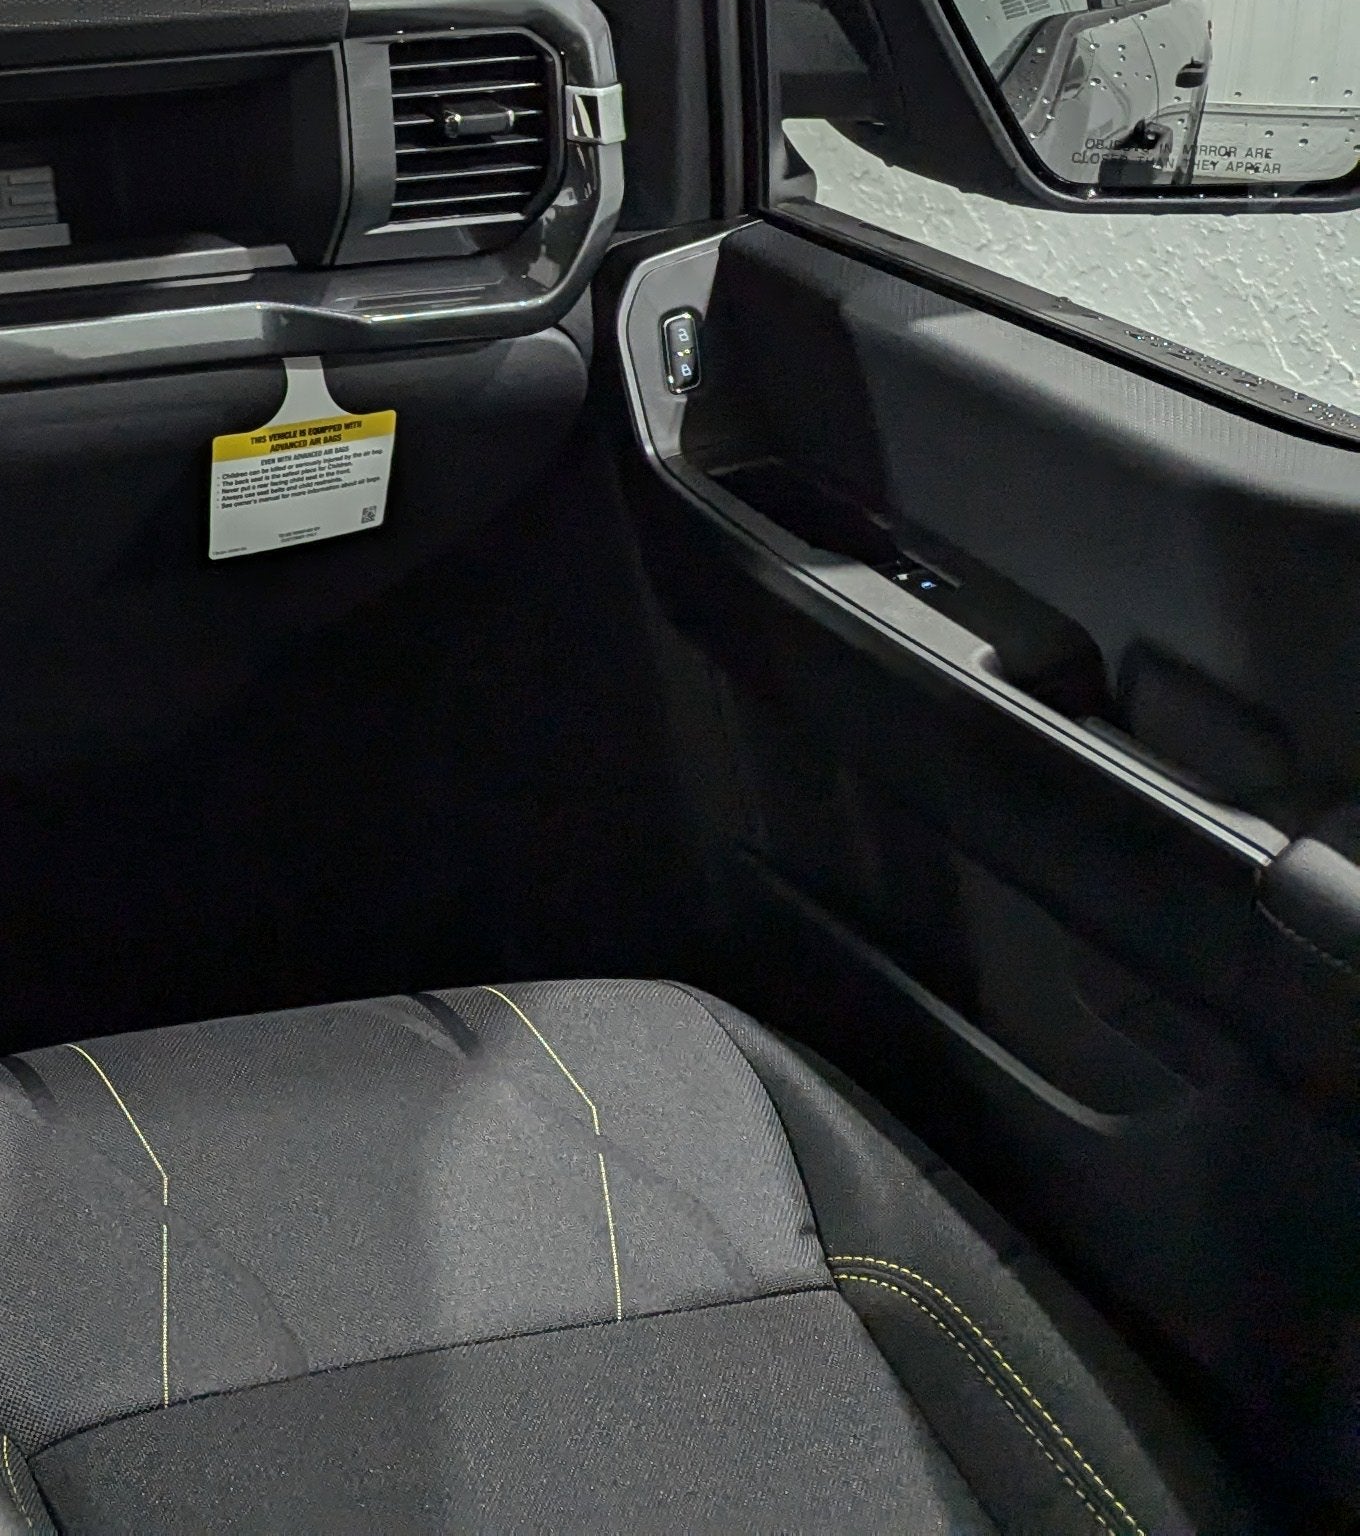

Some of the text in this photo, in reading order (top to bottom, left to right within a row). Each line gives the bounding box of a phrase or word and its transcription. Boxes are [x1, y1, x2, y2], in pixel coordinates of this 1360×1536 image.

[1245, 147, 1274, 159] ARE
[251, 420, 362, 445] THIS VEHICLE IS EQUIPPED WITH
[270, 433, 342, 453] ADVANCED AIR BAGS
